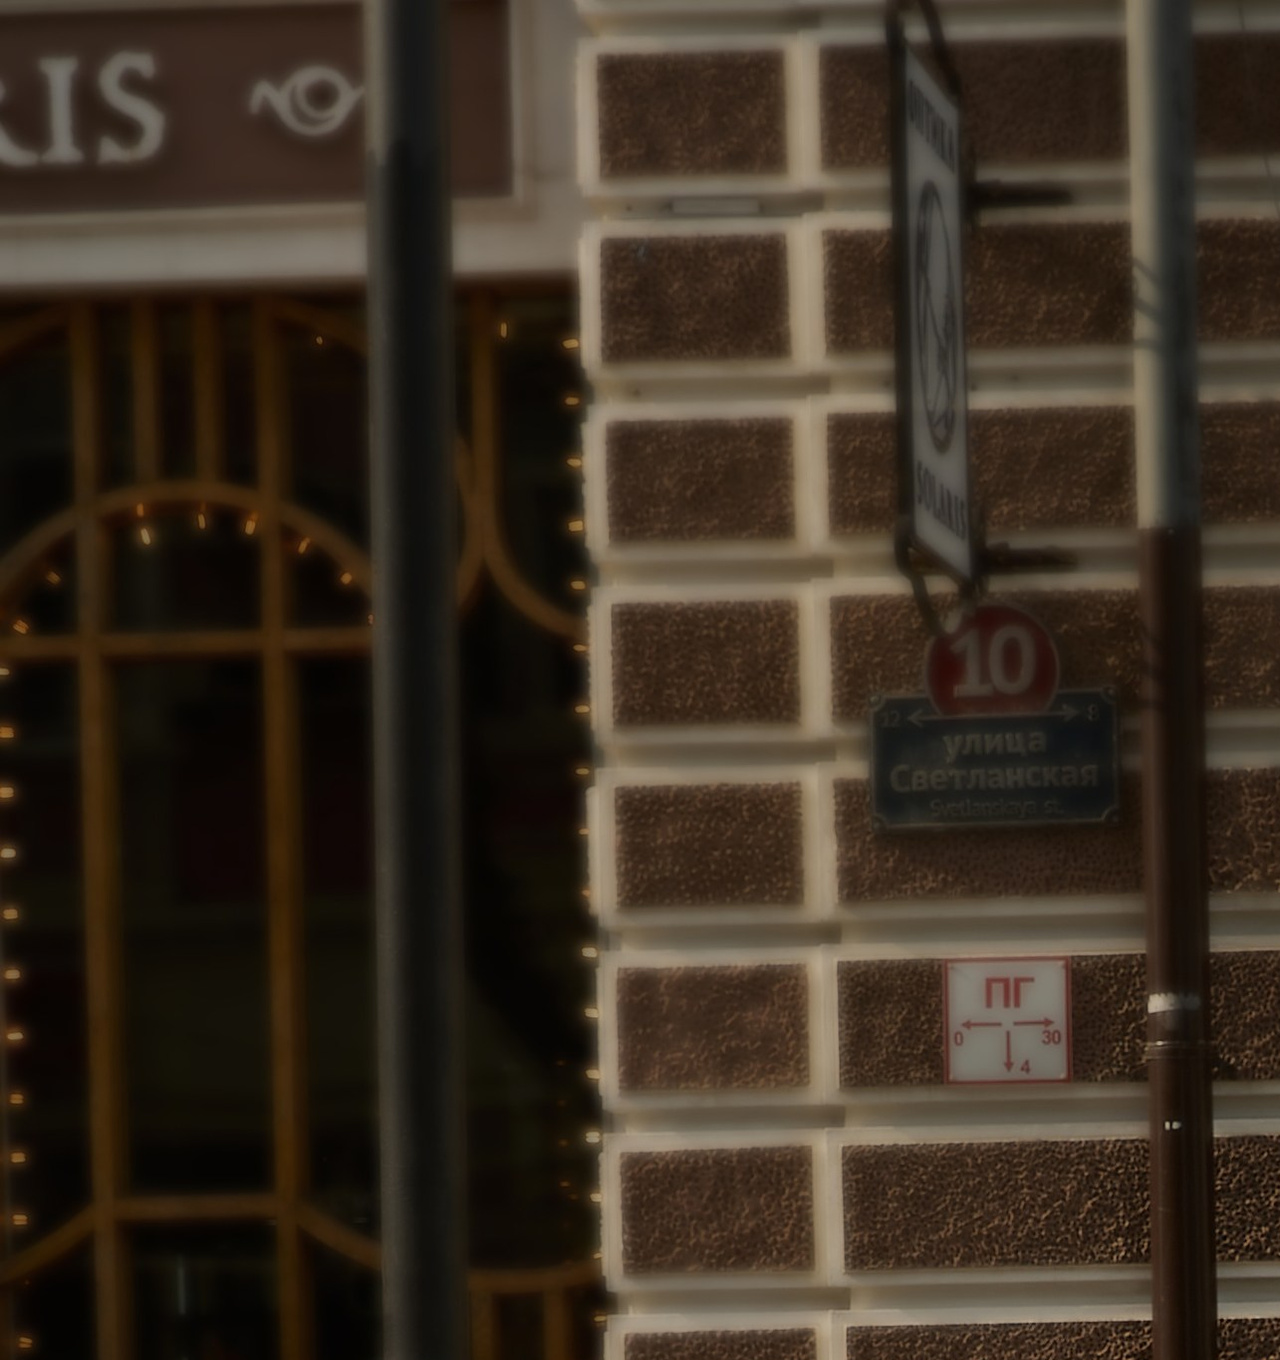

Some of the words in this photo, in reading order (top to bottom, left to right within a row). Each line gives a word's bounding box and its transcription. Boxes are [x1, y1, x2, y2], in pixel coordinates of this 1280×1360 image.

[917, 461, 967, 540] SOLARIS
[953, 624, 1037, 698] 10
[942, 731, 1047, 763] улица
[889, 763, 1099, 794] Светланская
[929, 798, 1037, 819] Svetlanskaya
[985, 976, 1035, 1009] ПГ
[954, 1030, 964, 1047] 0
[1041, 1029, 1062, 1046] 30
[1020, 1058, 1032, 1074] 4
